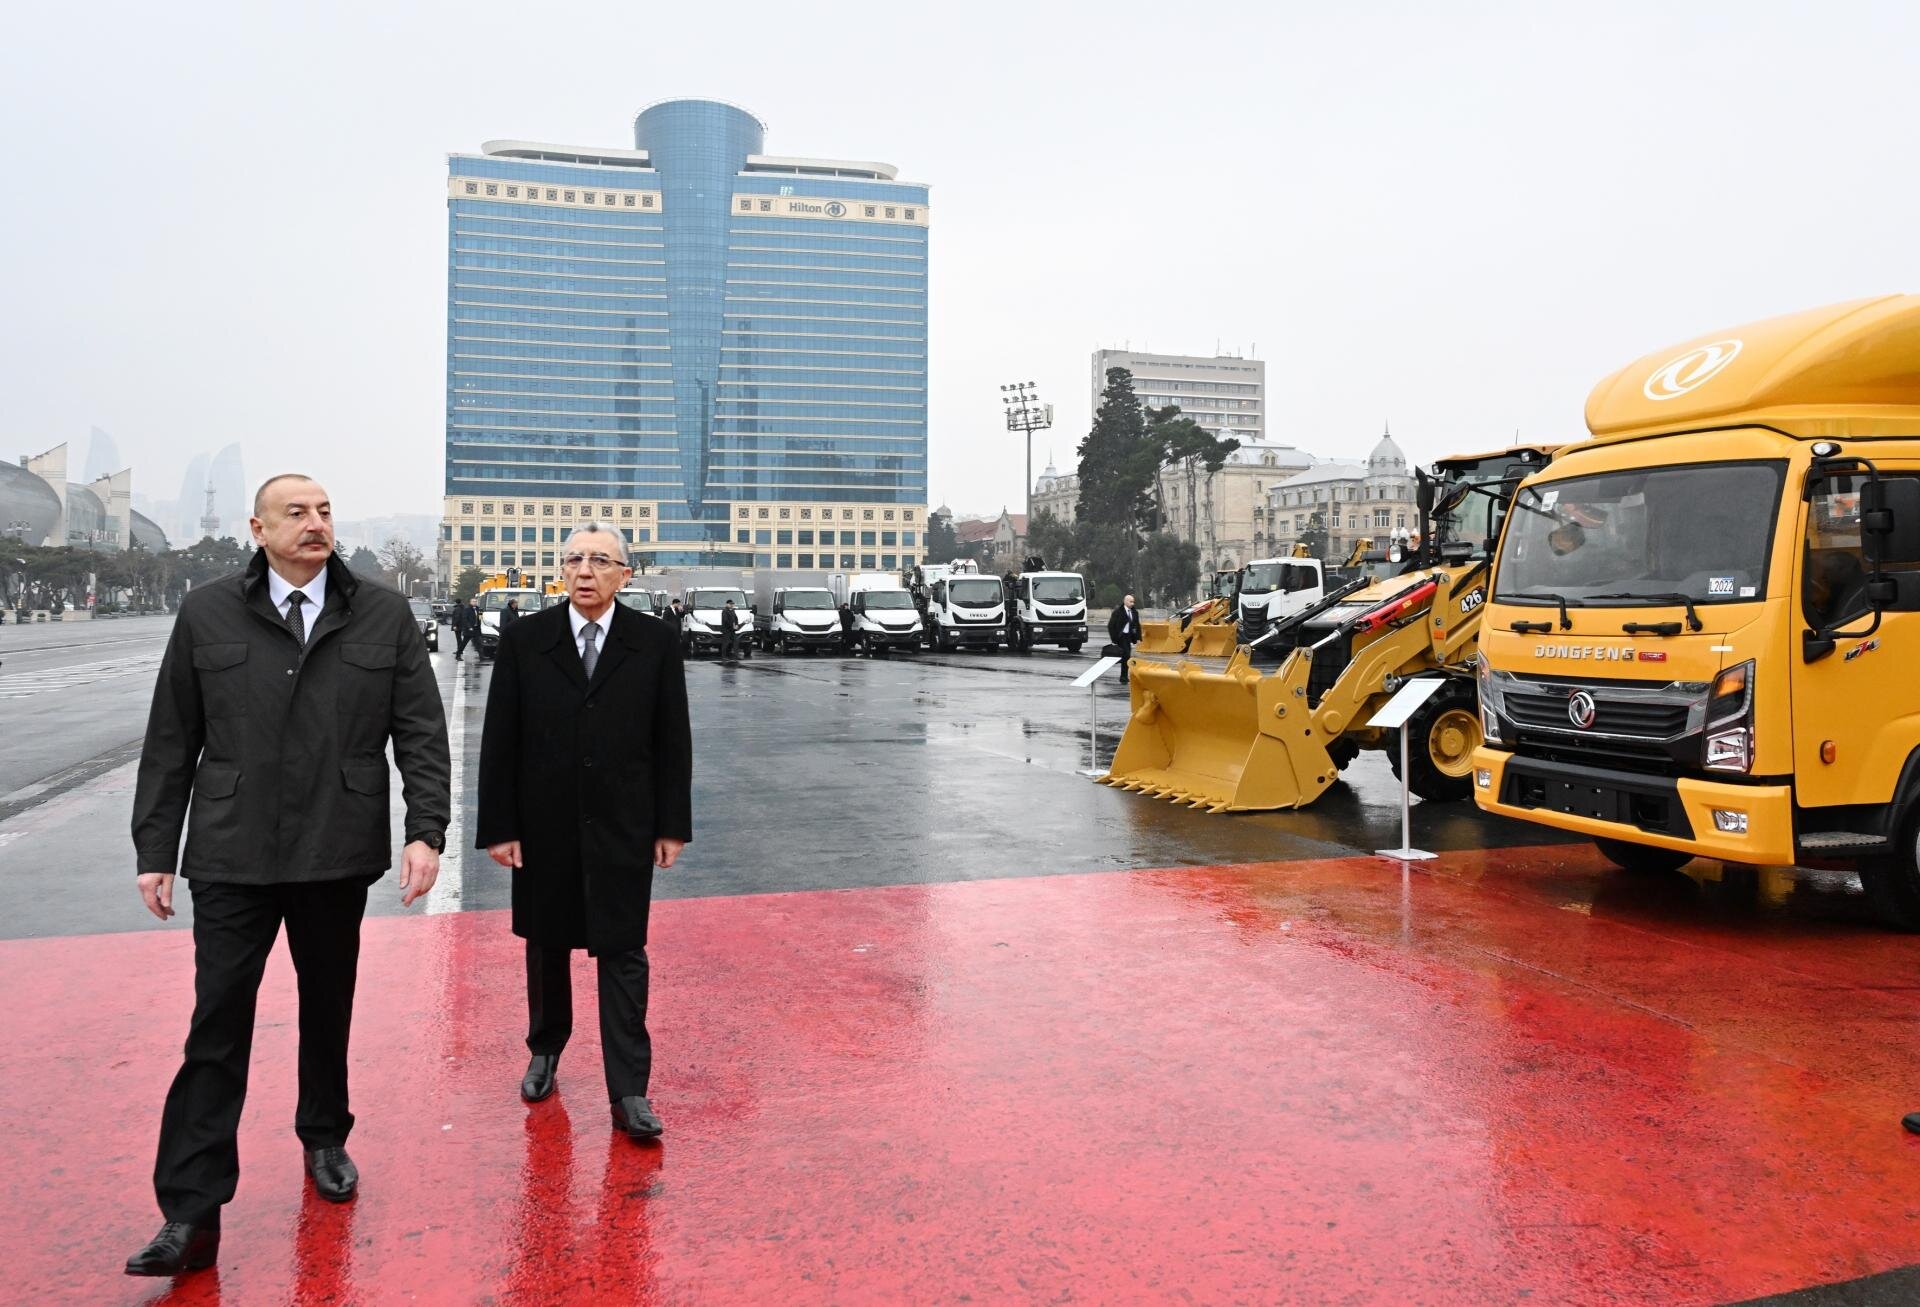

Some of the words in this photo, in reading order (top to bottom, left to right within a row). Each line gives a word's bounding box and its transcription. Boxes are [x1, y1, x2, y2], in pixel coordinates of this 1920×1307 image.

[789, 202, 822, 213] Hilton
[1460, 589, 1483, 613] 426
[1534, 644, 1635, 661] DONGFENG
